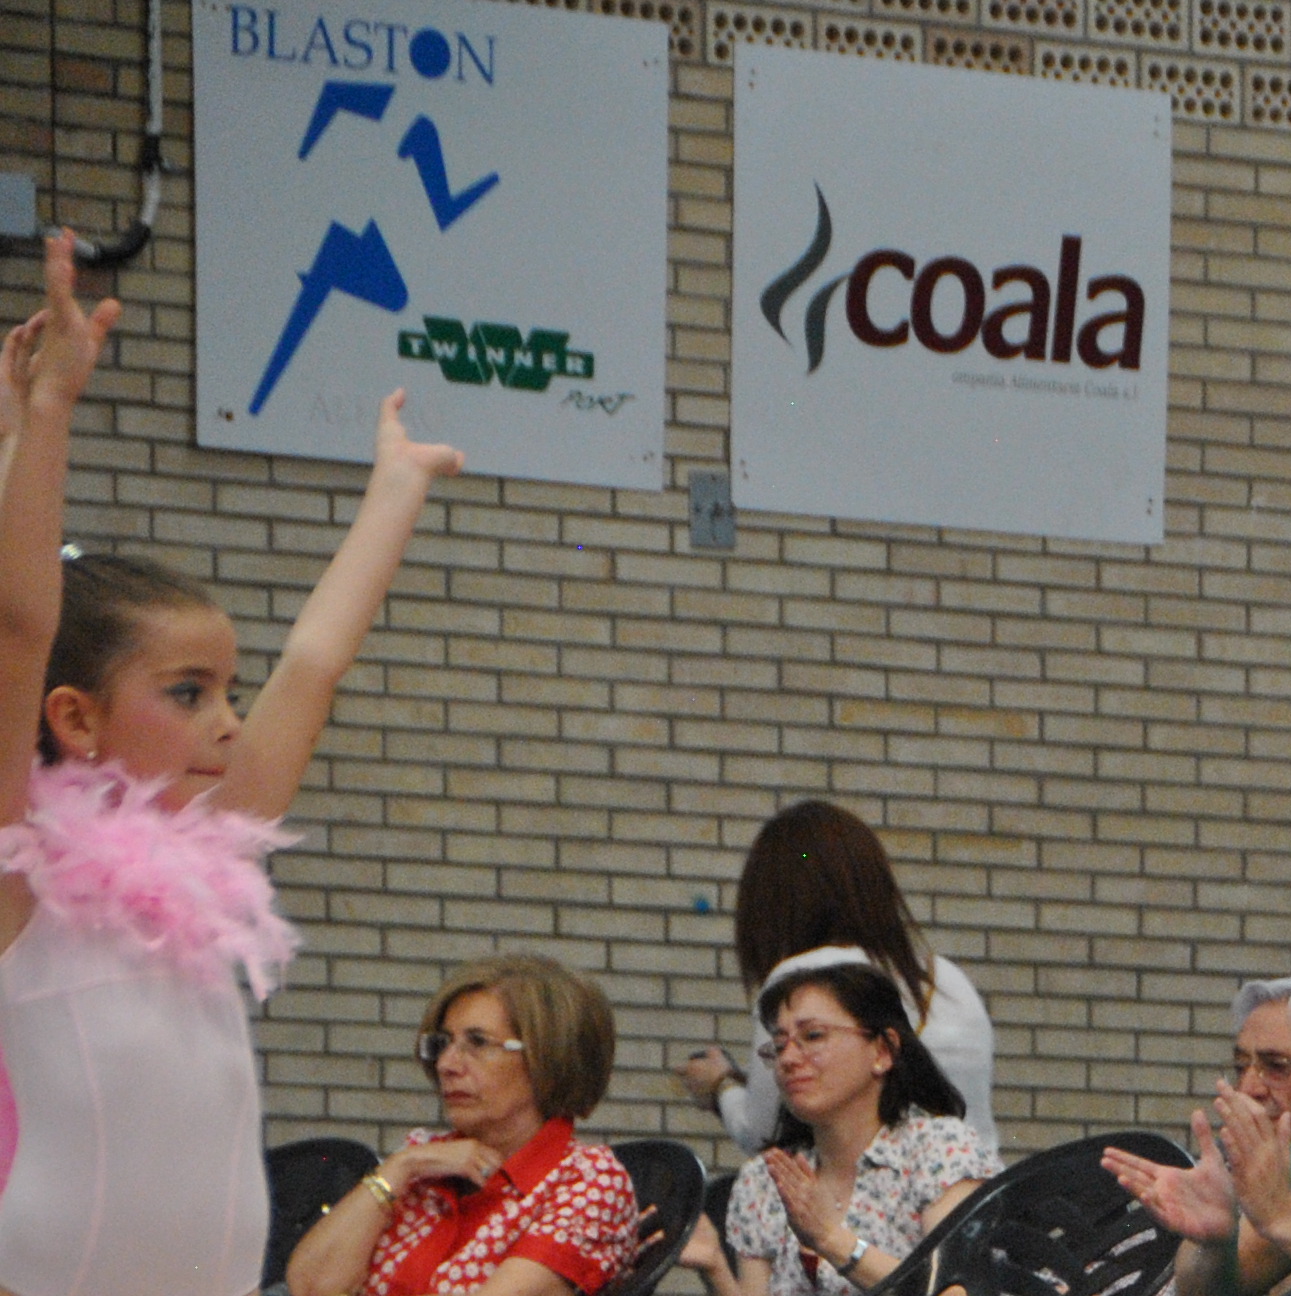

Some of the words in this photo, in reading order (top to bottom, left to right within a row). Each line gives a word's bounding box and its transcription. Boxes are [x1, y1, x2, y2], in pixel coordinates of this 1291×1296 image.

[230, 4, 497, 87] BLASTON
[846, 234, 1146, 371] coala
[404, 335, 588, 376] TWINNER
